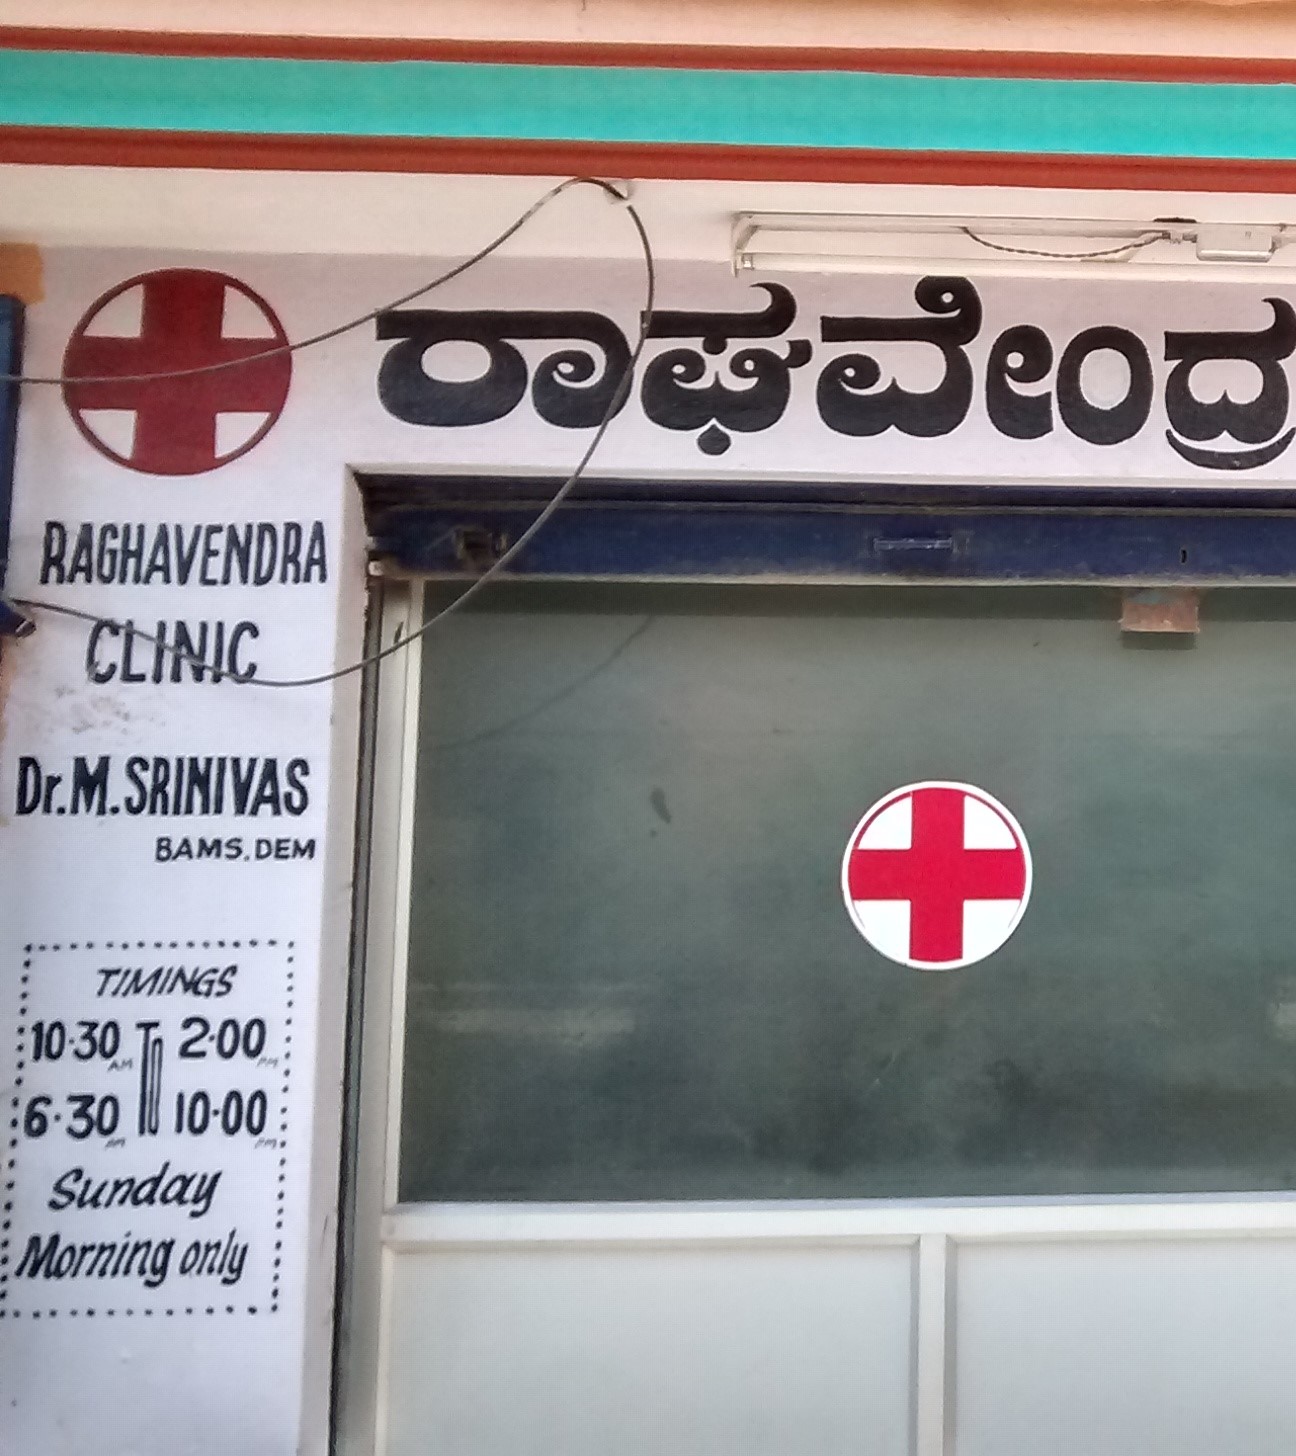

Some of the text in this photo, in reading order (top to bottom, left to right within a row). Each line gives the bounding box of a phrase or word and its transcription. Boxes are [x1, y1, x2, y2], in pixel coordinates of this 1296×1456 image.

[40, 520, 328, 586] RAGHAVENDRA
[86, 619, 260, 684] CLINIC
[97, 964, 238, 998] TIMINGS
[48, 1160, 222, 1219] Sunday
[15, 1227, 248, 1288] Morning only
